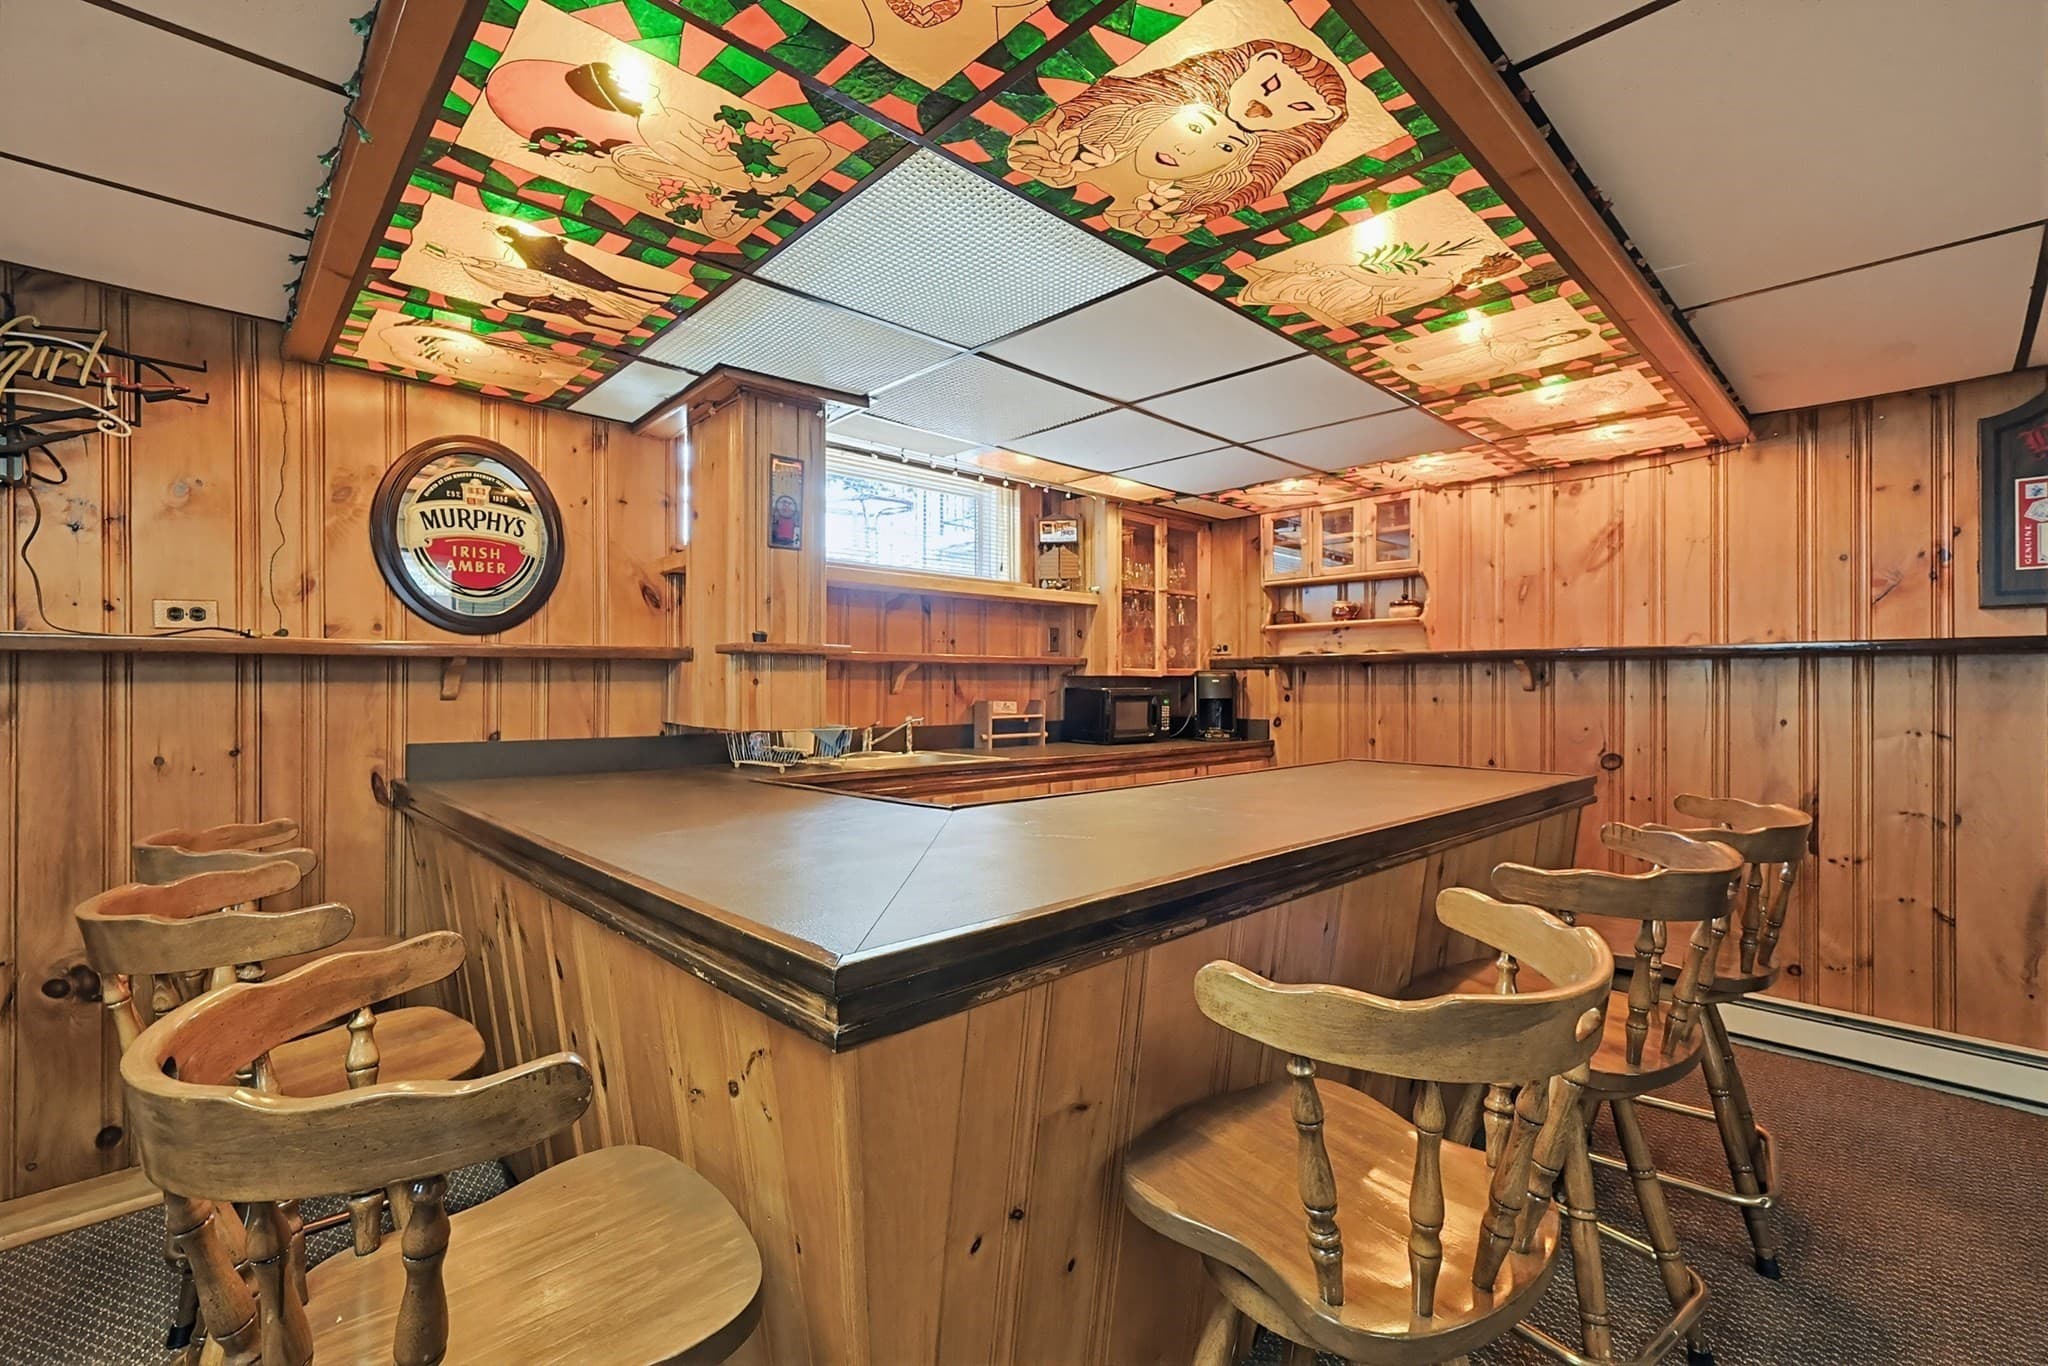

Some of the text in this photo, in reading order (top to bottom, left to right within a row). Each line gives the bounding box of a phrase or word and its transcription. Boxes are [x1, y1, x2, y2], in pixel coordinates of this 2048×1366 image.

[419, 508, 527, 538] MURPHY'S
[452, 545, 501, 560] IRISH
[2024, 523, 2033, 565] GENUINE
[446, 559, 506, 575] AMBER
